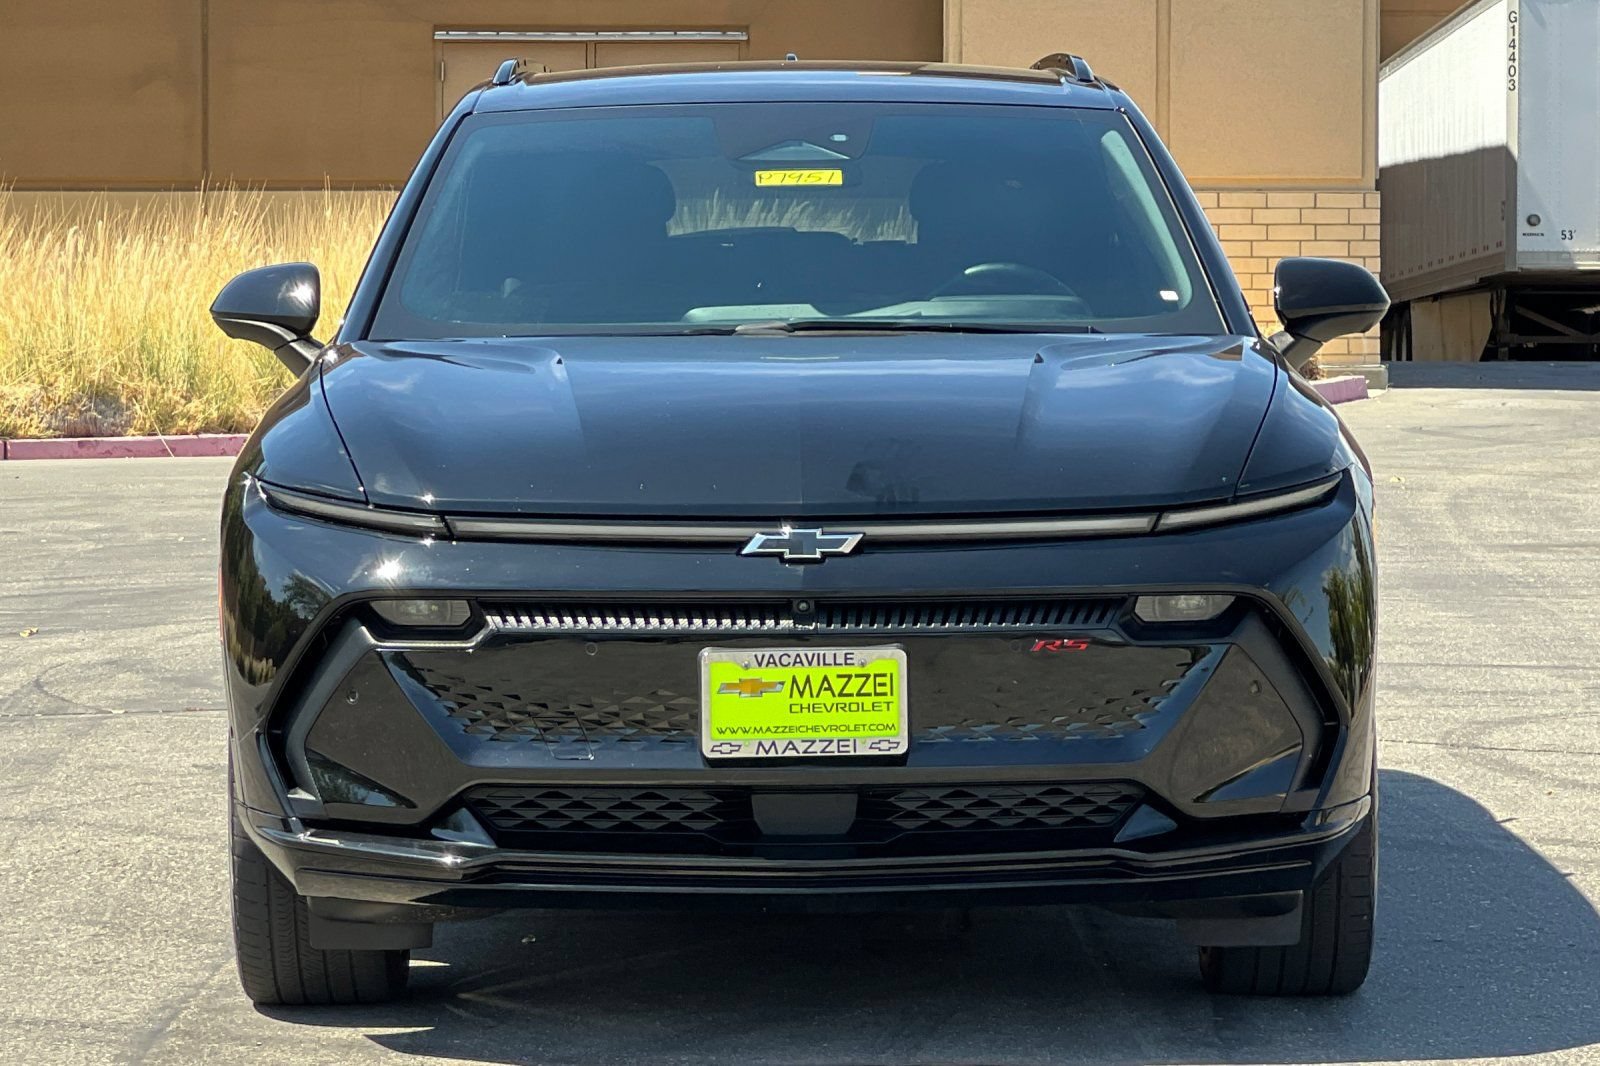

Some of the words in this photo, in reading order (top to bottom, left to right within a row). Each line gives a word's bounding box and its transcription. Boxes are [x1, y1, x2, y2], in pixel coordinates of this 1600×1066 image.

[1508, 10, 1518, 92] G14403
[1030, 639, 1089, 653] RS
[754, 652, 856, 668] VACAVILLE
[789, 673, 895, 699] MAZZEI
[789, 701, 894, 714] CHEVROLET
[716, 723, 897, 735] WWW.MAZZEICHEVROLET.COM
[755, 738, 858, 756] MAZZEI
